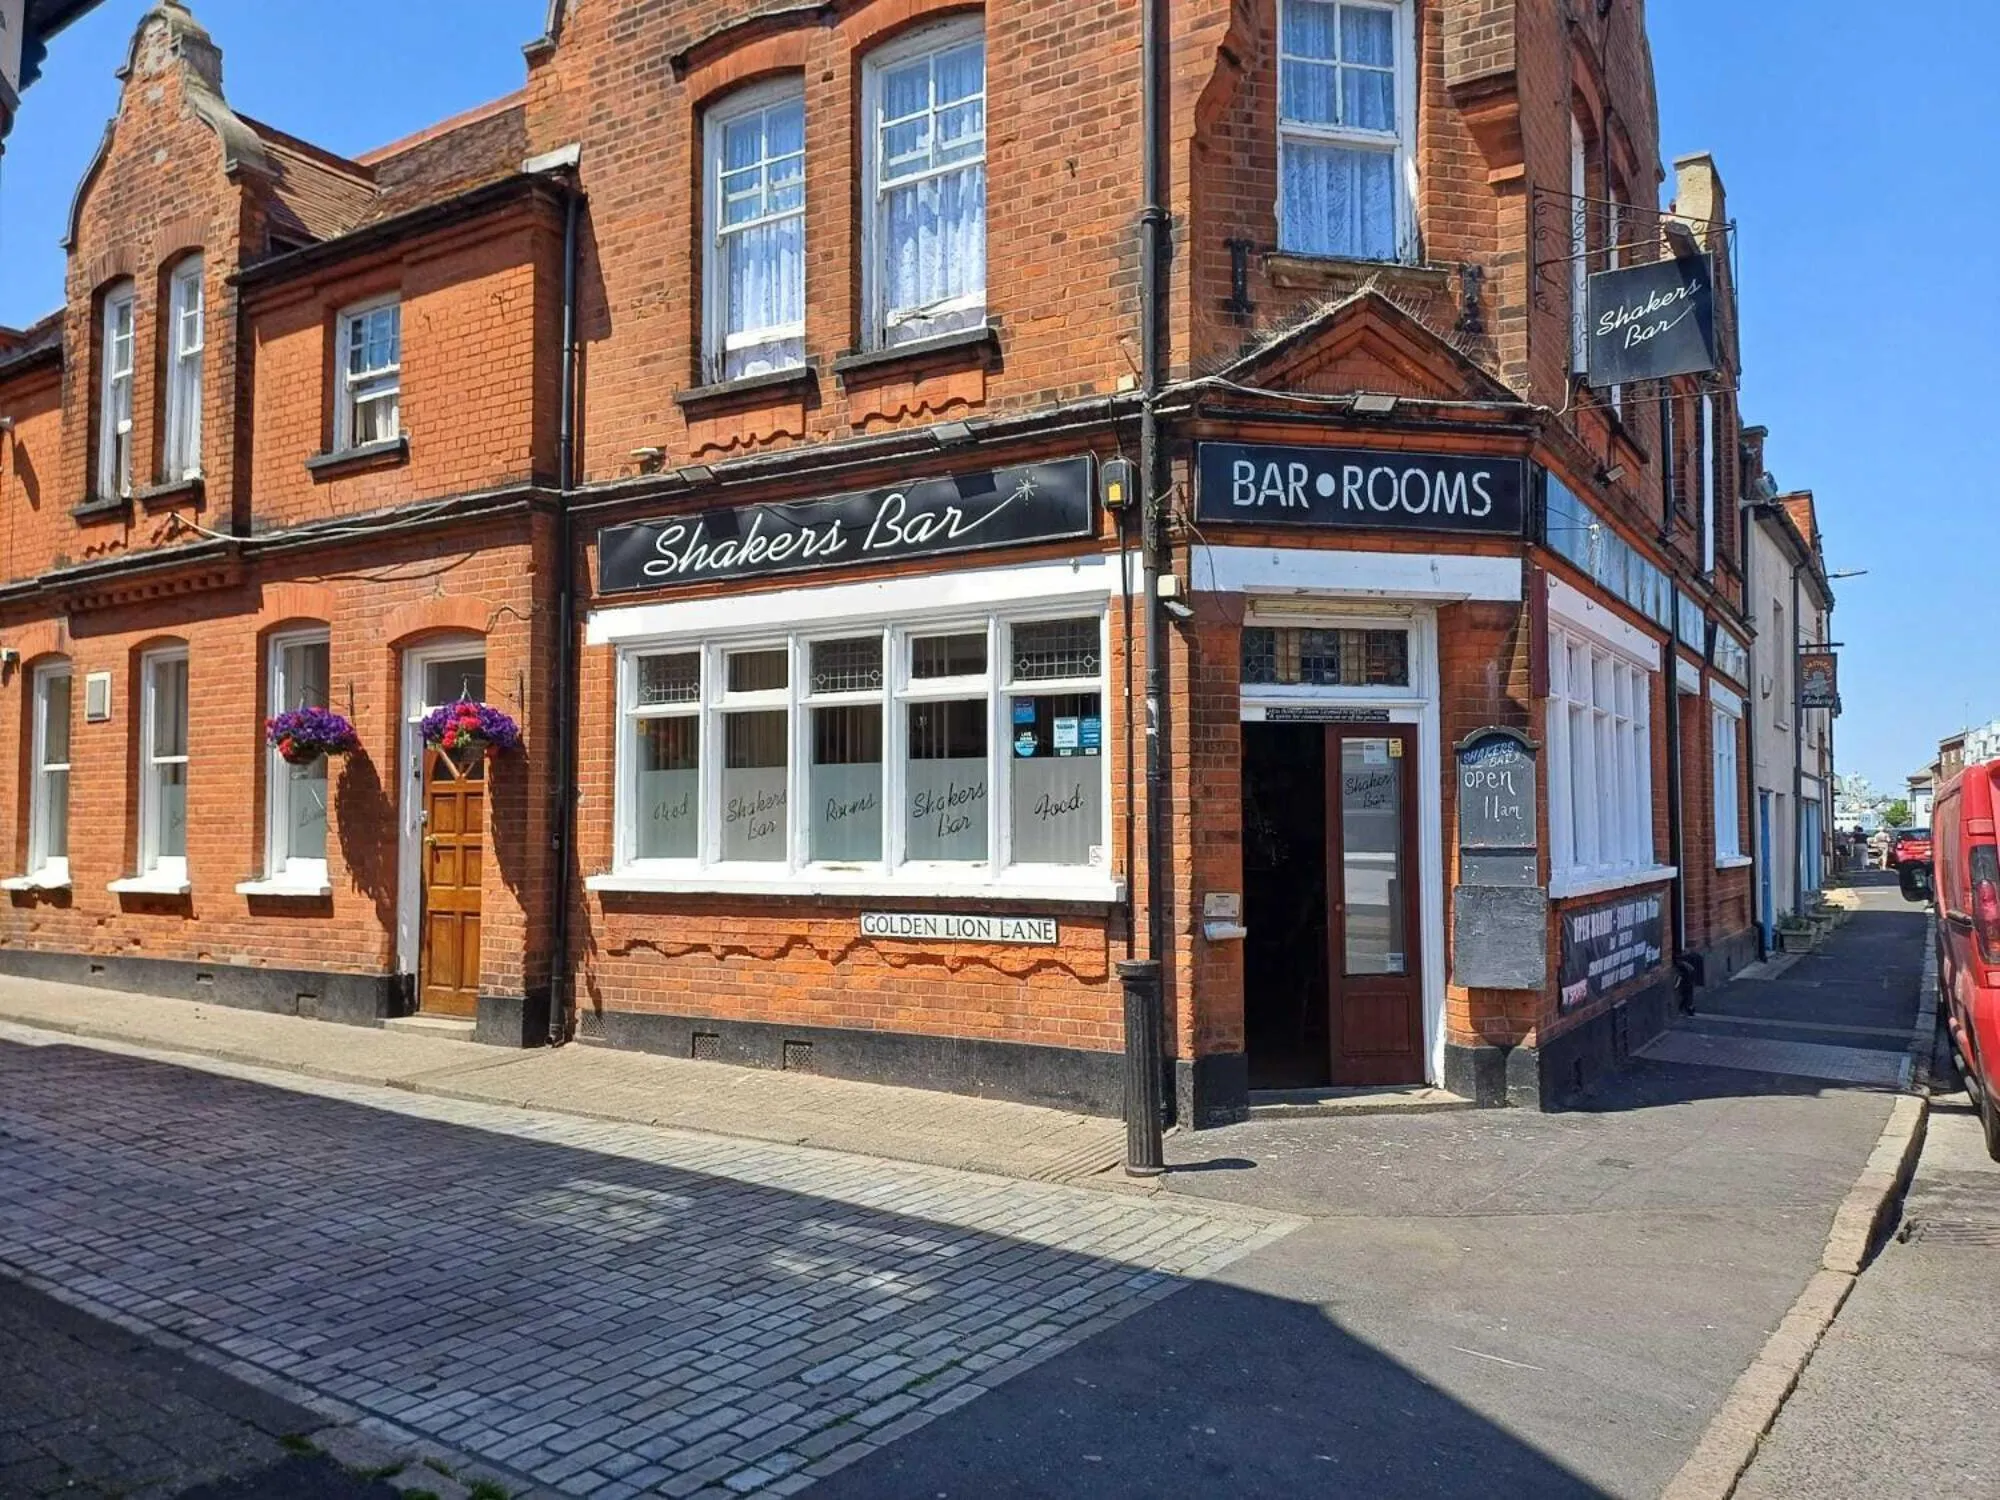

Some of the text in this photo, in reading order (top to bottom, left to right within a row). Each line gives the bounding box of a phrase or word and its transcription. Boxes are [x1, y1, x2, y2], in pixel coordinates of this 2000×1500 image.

[1595, 278, 1703, 337] Shakers
[1624, 311, 1684, 350] Bar
[1232, 459, 1492, 517] BAR ROOMS
[642, 493, 990, 577] Shakers Bar
[912, 782, 987, 818] Shakers
[1464, 770, 1516, 796] open
[726, 789, 788, 822] Shakers
[1484, 795, 1523, 822] 11am
[937, 812, 973, 838] Bar
[863, 915, 1054, 941] GOLDEN LION LANE
